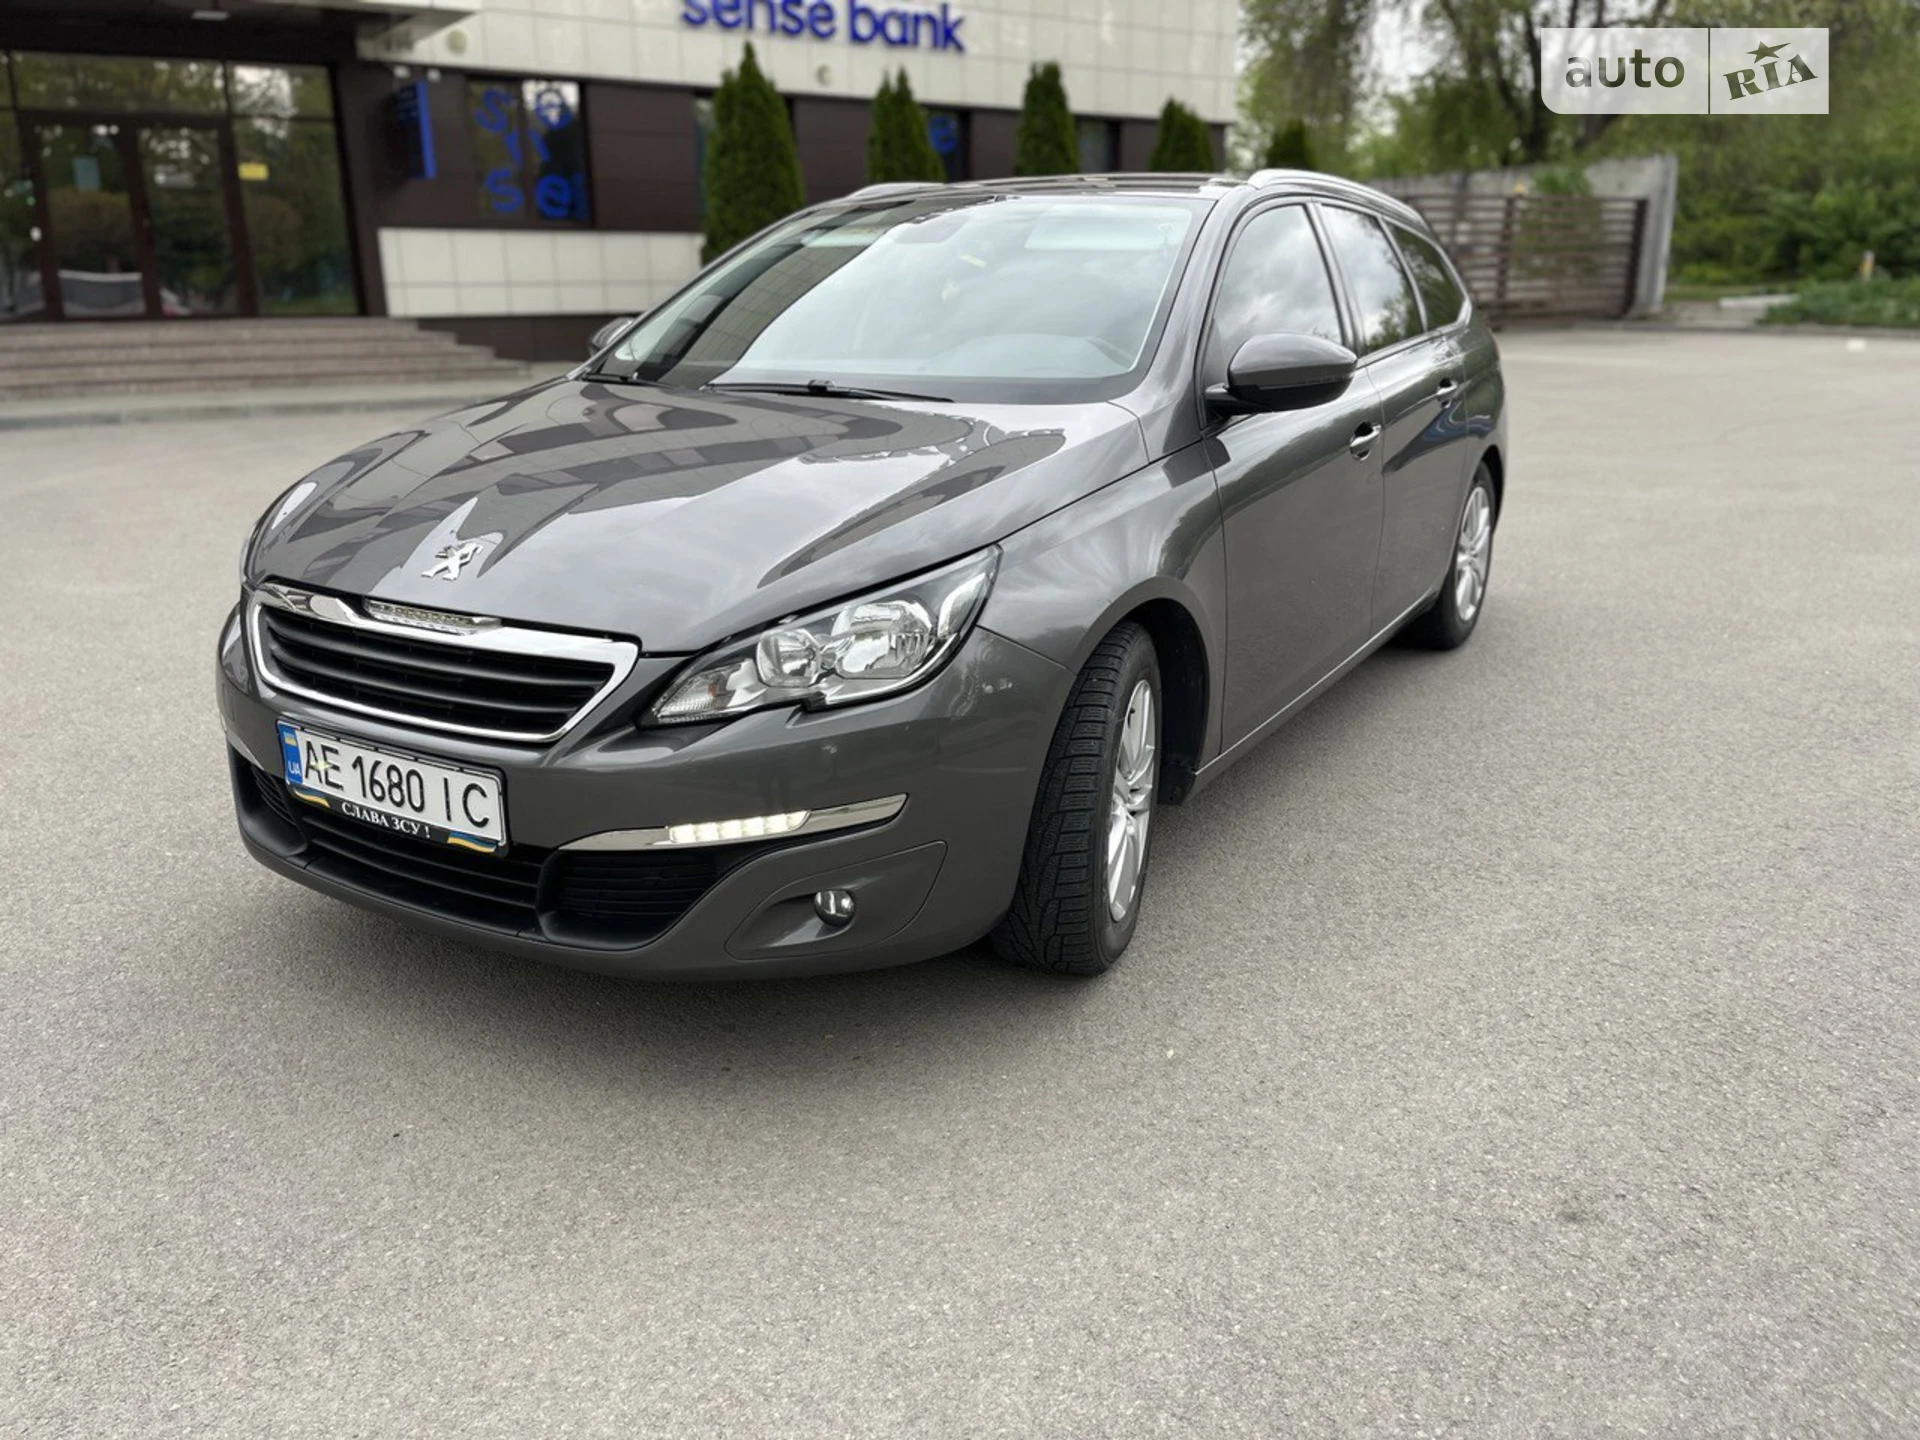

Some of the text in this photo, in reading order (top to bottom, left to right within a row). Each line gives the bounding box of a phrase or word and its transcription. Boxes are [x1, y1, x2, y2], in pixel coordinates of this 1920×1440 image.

[681, 0, 965, 52] sense bank
[305, 740, 490, 829] AE 1680 IC
[341, 801, 389, 828] СЛАВА
[391, 816, 421, 835] ЗСУ
